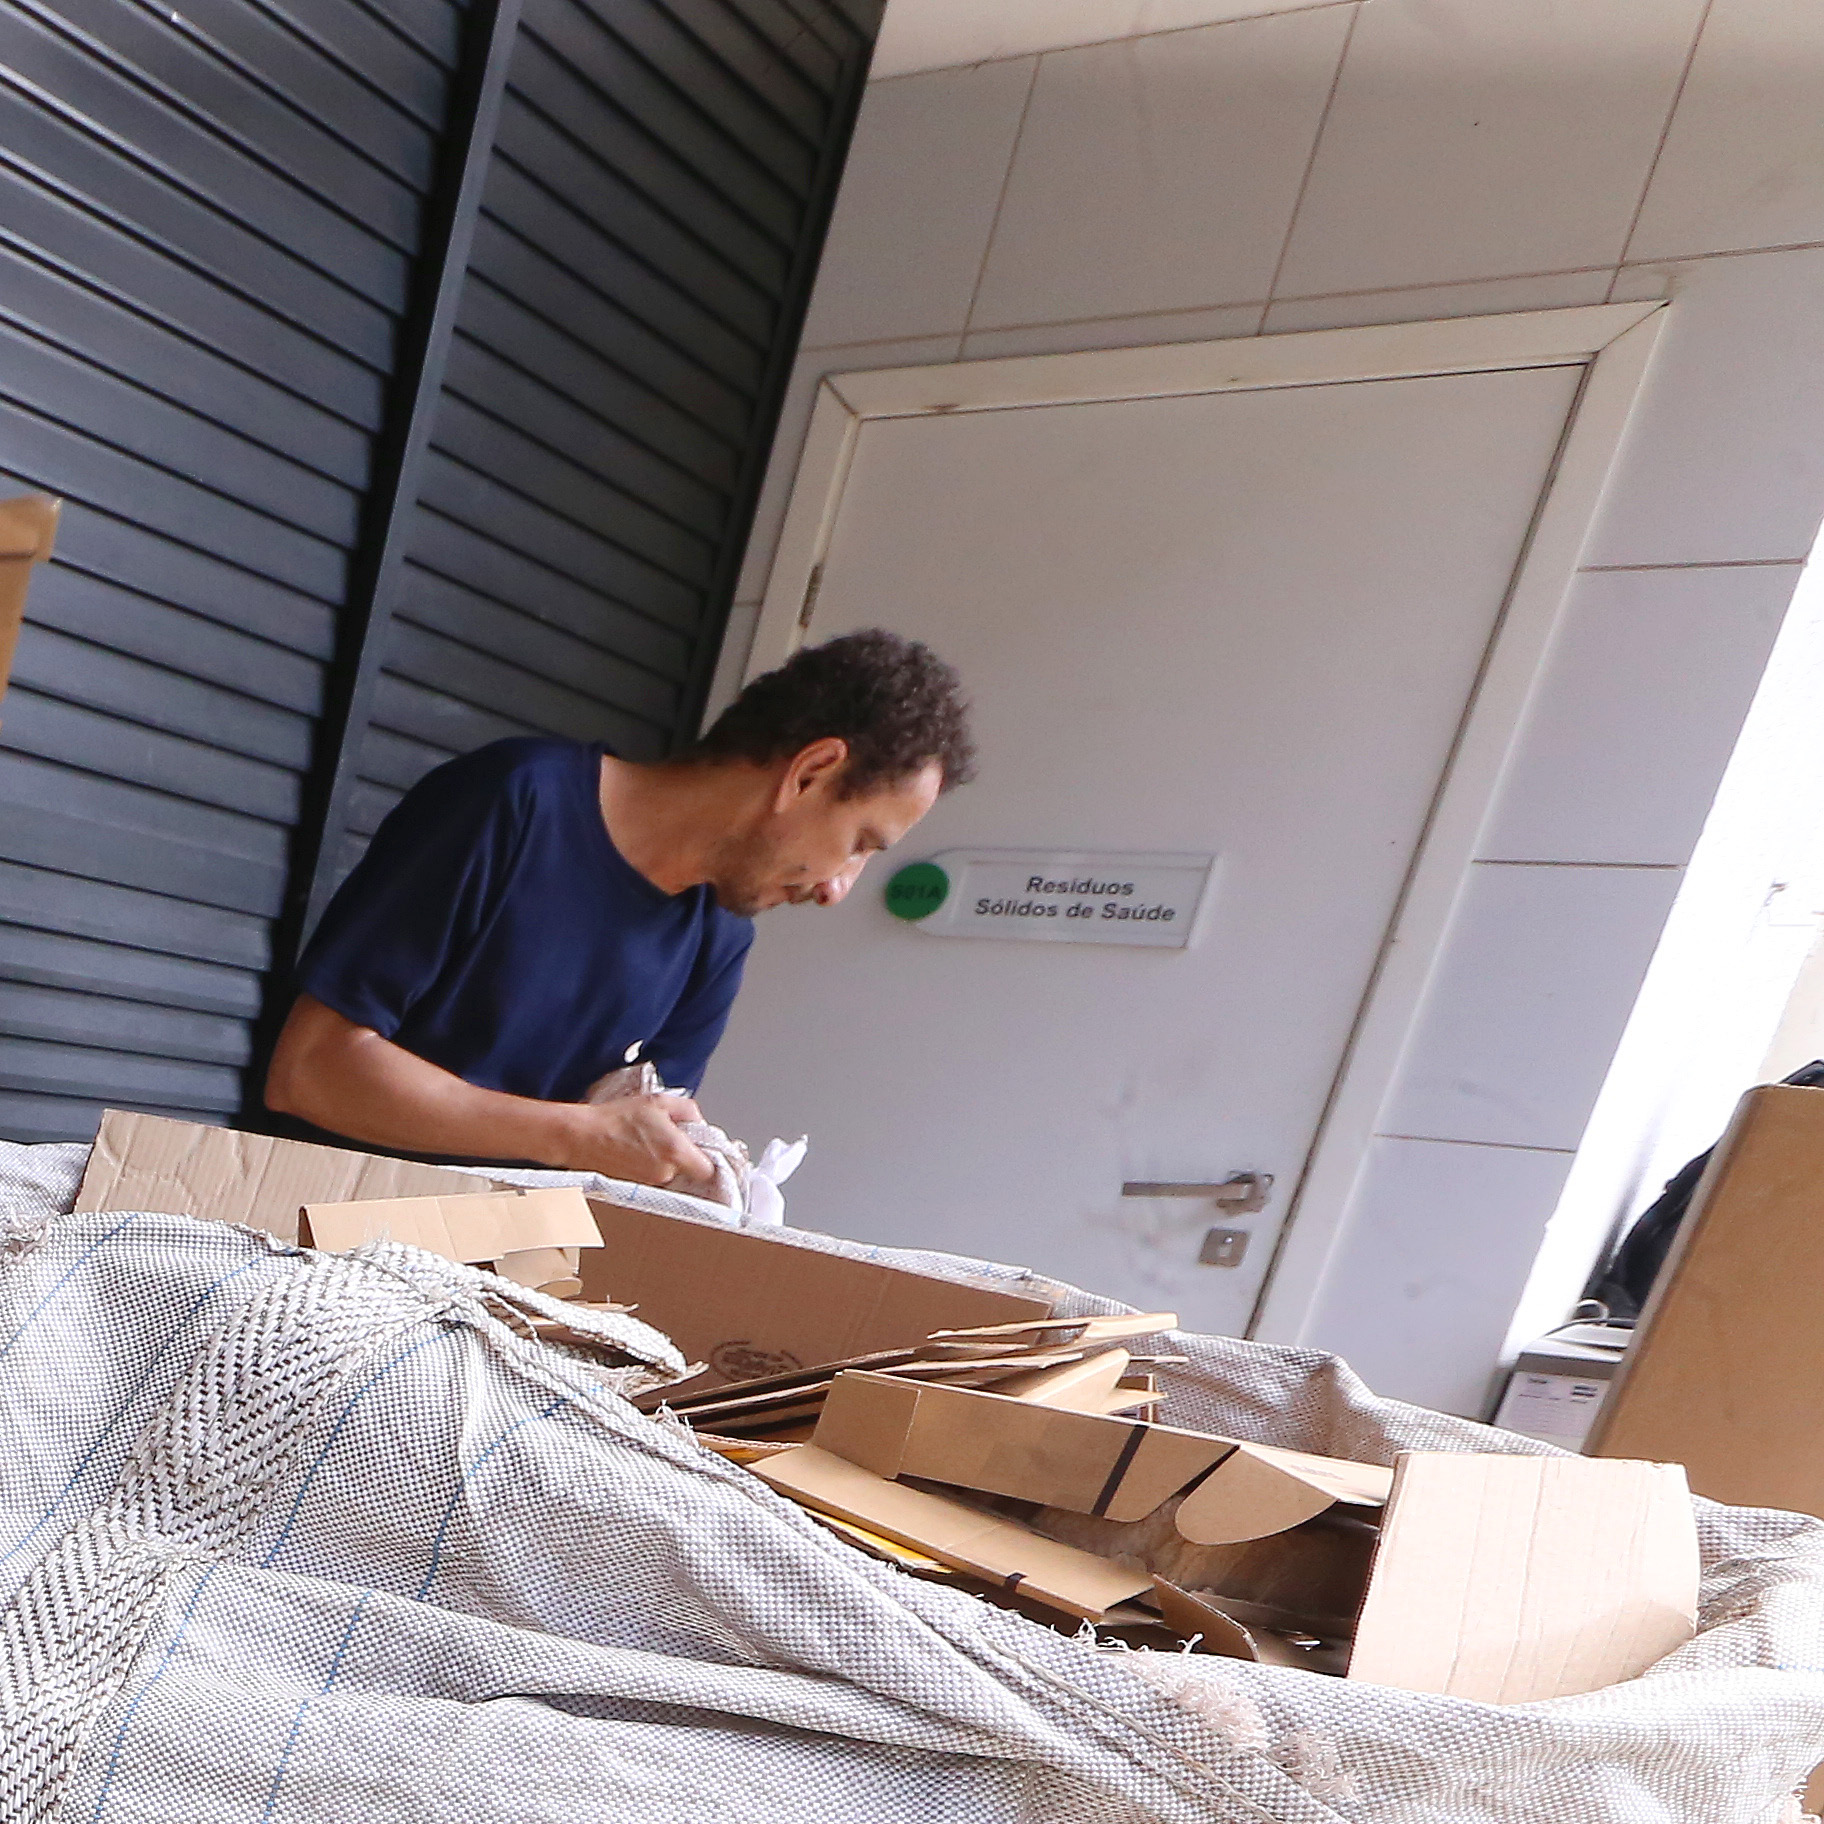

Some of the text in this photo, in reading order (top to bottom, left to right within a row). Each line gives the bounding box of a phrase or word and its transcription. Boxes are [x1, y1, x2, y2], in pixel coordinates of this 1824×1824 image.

[1025, 876, 1135, 897] Resíduos
[974, 898, 1177, 923] Sólidos de Saúde
